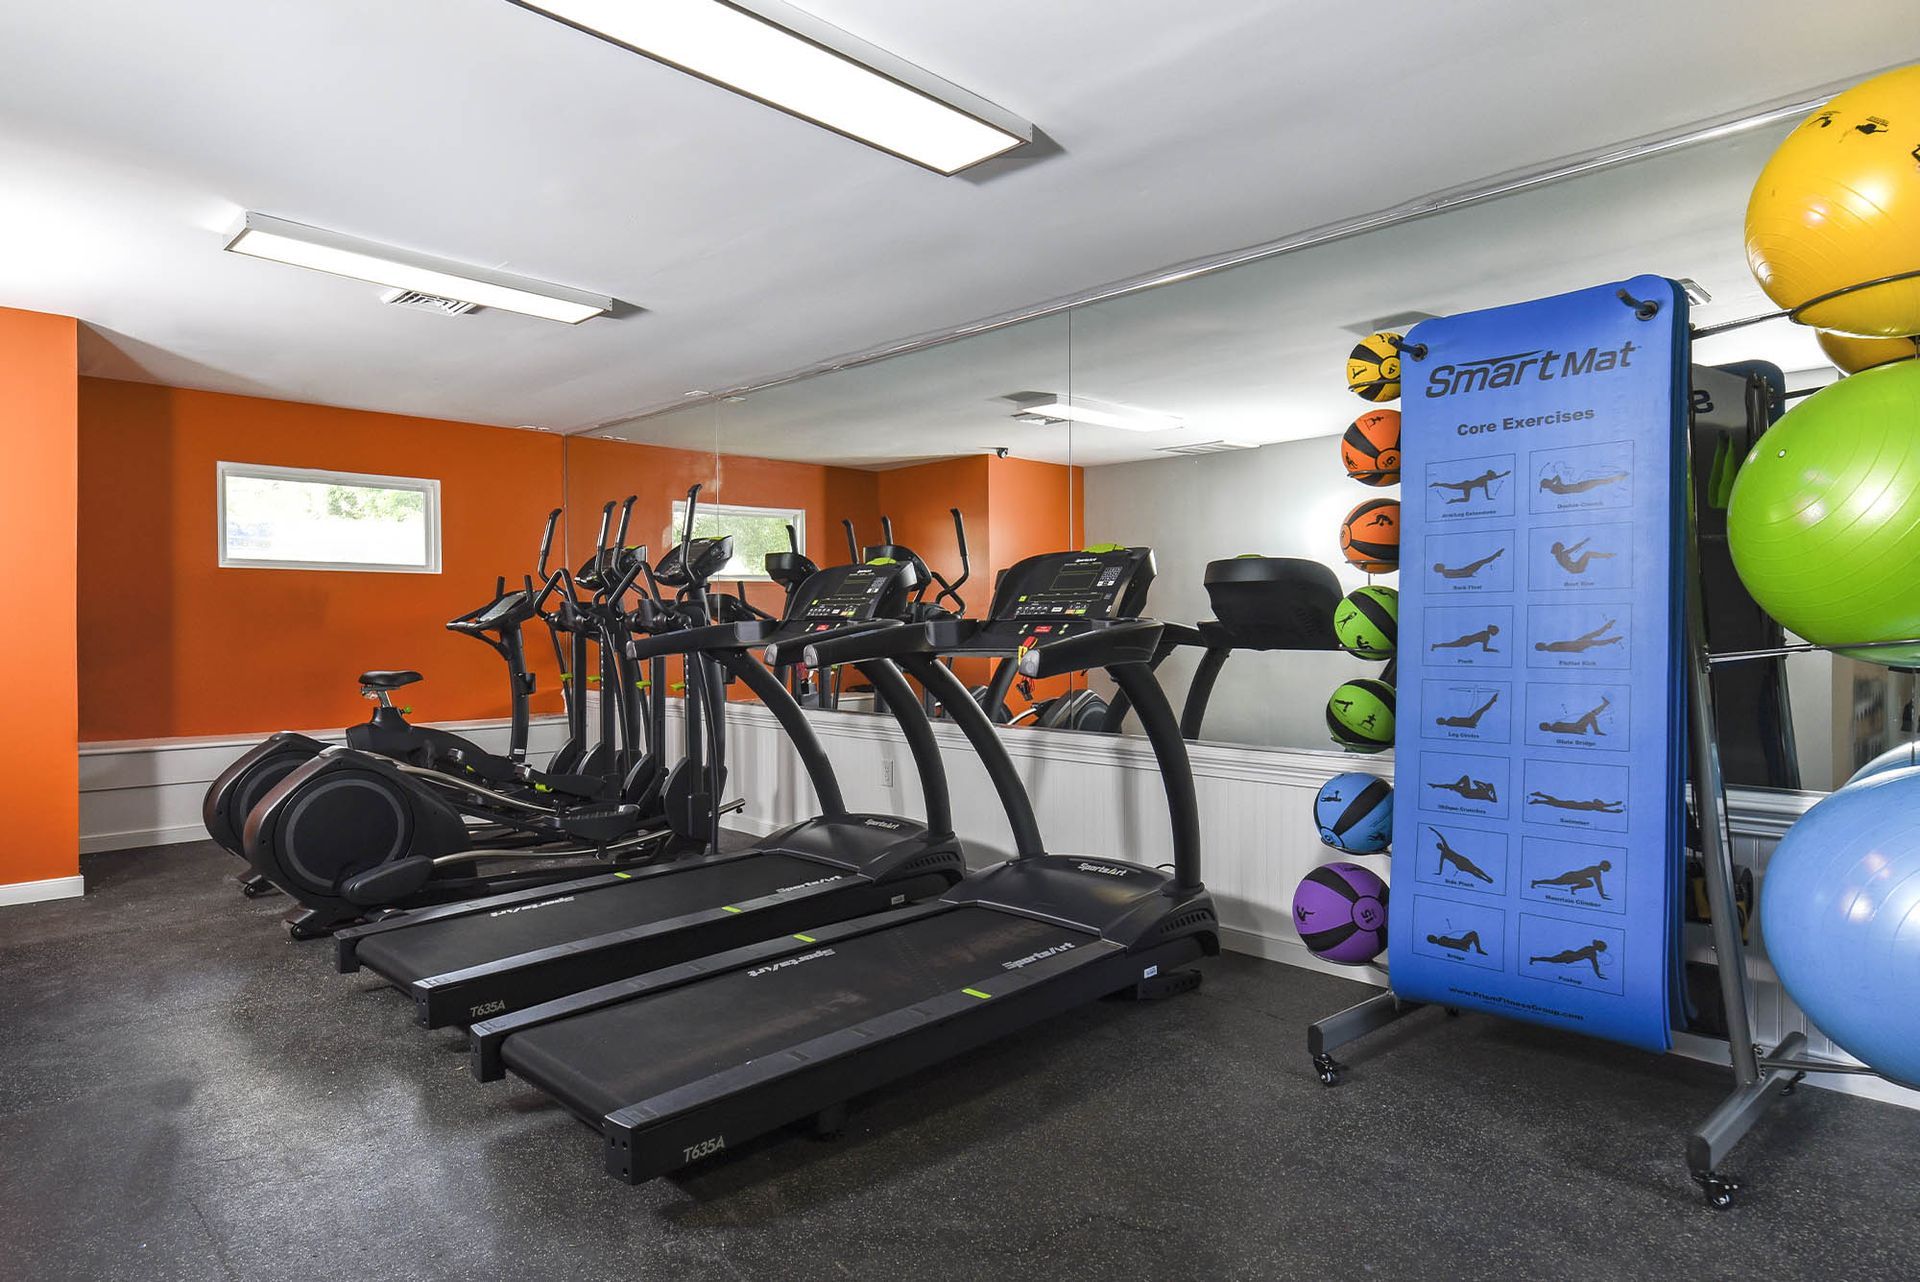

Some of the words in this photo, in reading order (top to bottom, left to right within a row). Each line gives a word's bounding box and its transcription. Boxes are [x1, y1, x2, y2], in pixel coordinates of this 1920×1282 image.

[1425, 349, 1561, 398] Smart
[1457, 422, 1498, 437] Core
[1502, 407, 1596, 431] Exercises
[1077, 862, 1127, 876] SportsArt
[1545, 894, 1574, 904] Mountain
[1575, 898, 1602, 908] Climber
[1001, 942, 1076, 970] SportsArt
[469, 999, 506, 1018] T635A
[682, 1134, 726, 1163] T635A
